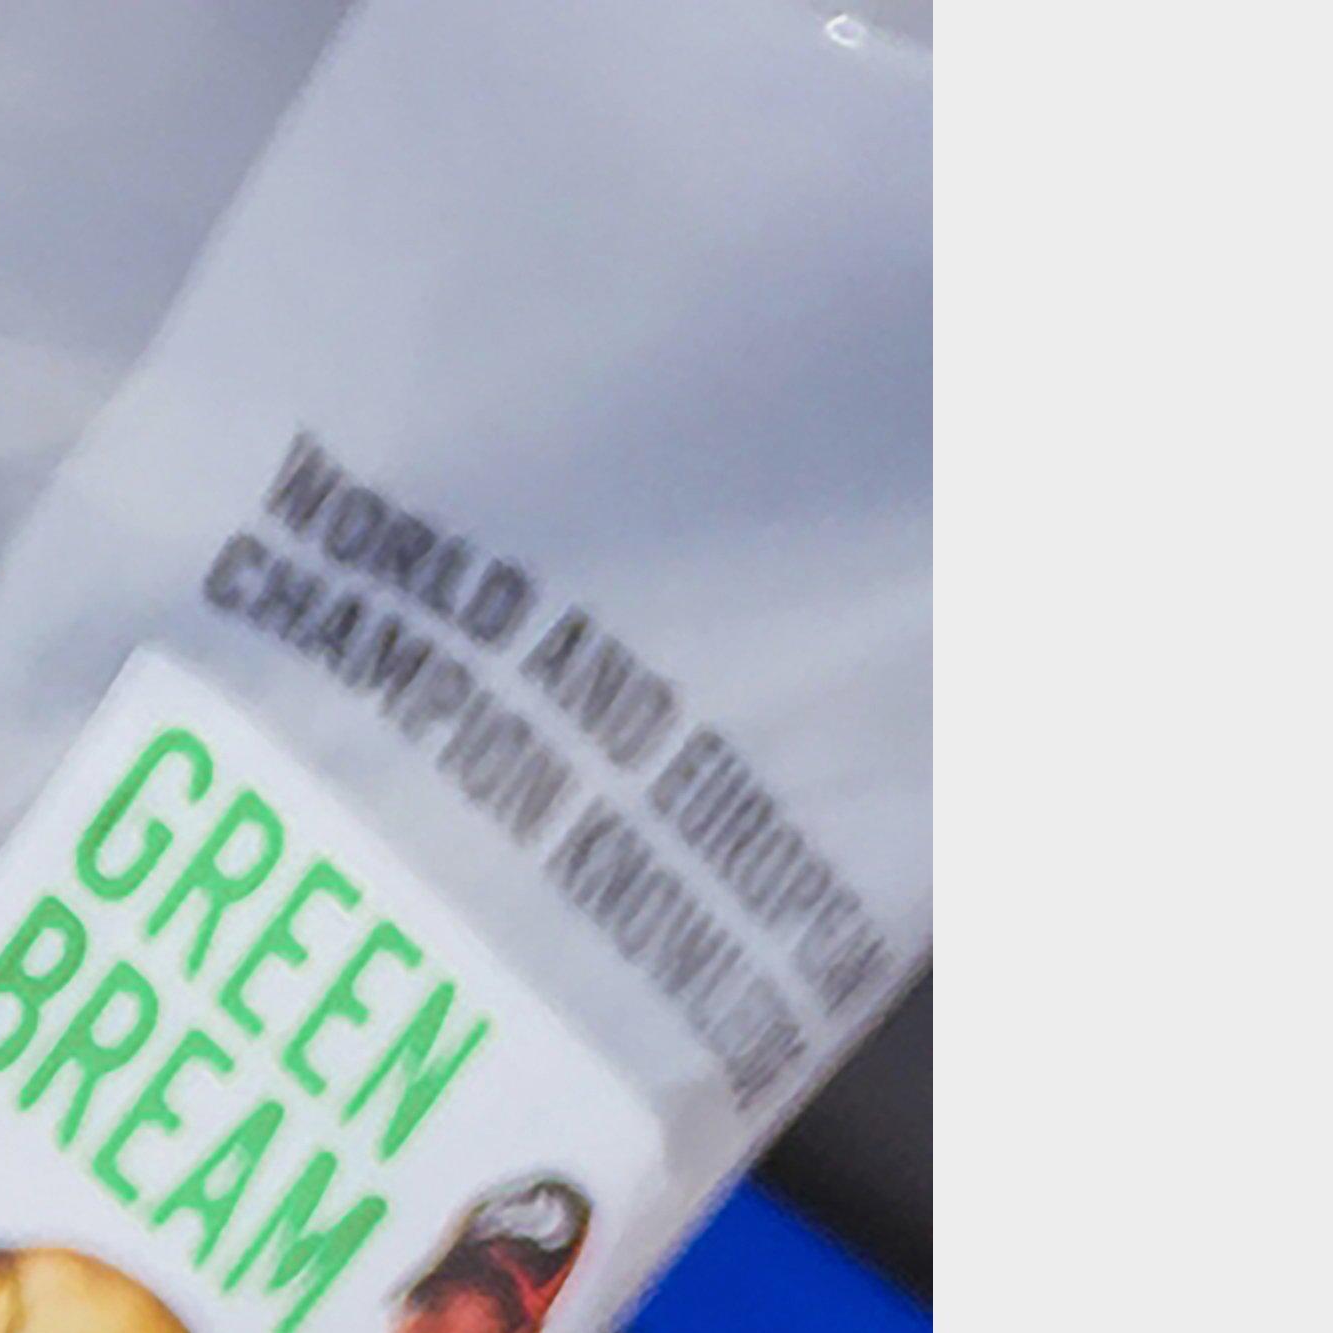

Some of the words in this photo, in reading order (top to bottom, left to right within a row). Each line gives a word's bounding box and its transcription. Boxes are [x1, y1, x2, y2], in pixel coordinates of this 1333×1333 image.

[74, 726, 490, 1160] GREEN
[203, 531, 573, 847] CHAMPION
[545, 797, 809, 1112] KNOWL
[266, 424, 535, 652] WORLD
[520, 604, 683, 772] AND
[646, 722, 890, 1017] EUROPE
